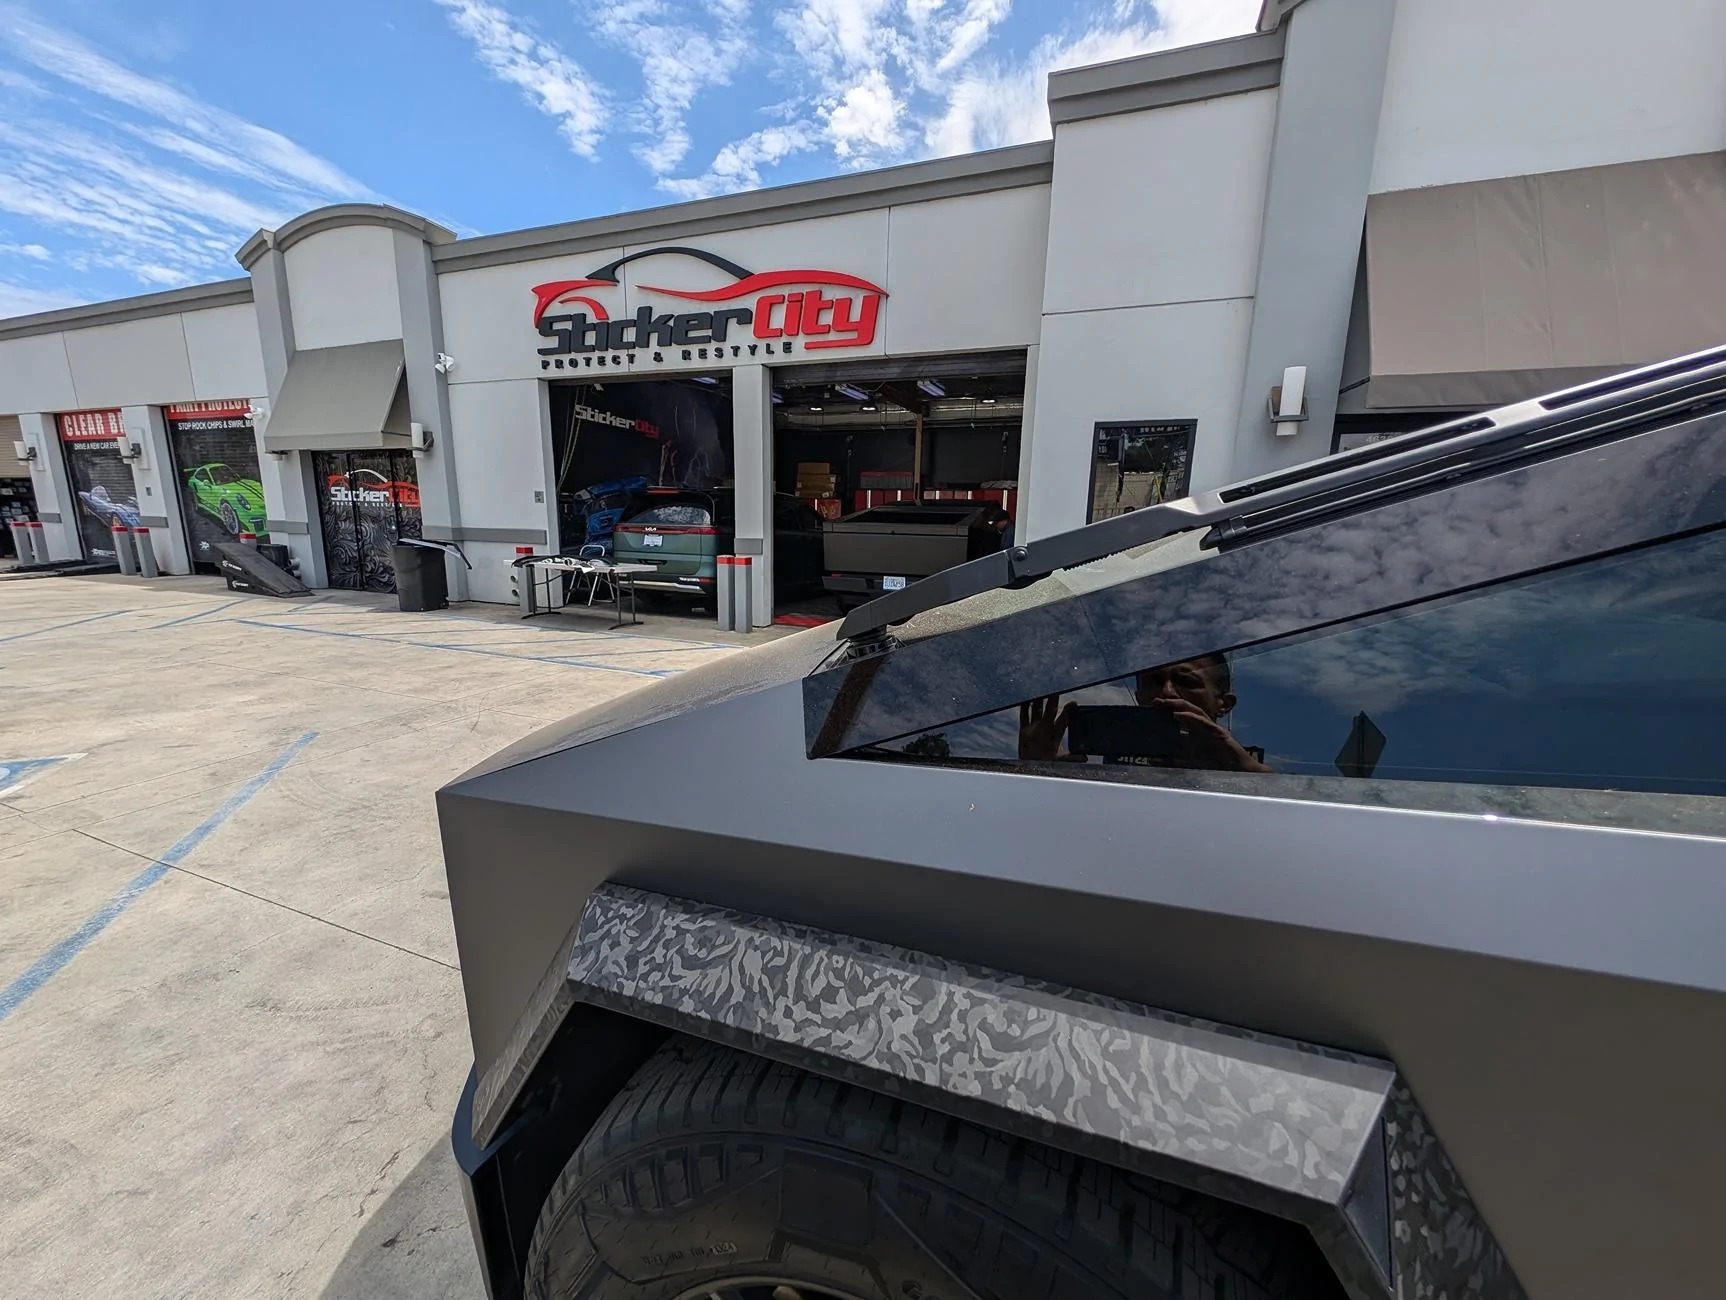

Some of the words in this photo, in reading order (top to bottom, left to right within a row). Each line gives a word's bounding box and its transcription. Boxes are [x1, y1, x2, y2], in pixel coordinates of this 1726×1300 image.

[541, 353, 636, 370] PROTECT
[652, 351, 664, 363] &
[681, 341, 793, 361] RESTYLE
[64, 413, 105, 437] CLEAR
[178, 422, 192, 431] STOP
[192, 421, 206, 430] ROCK
[207, 420, 223, 430] CHIPS
[223, 420, 228, 429] &
[228, 419, 245, 429] SWIRL
[100, 441, 110, 450] CAR
